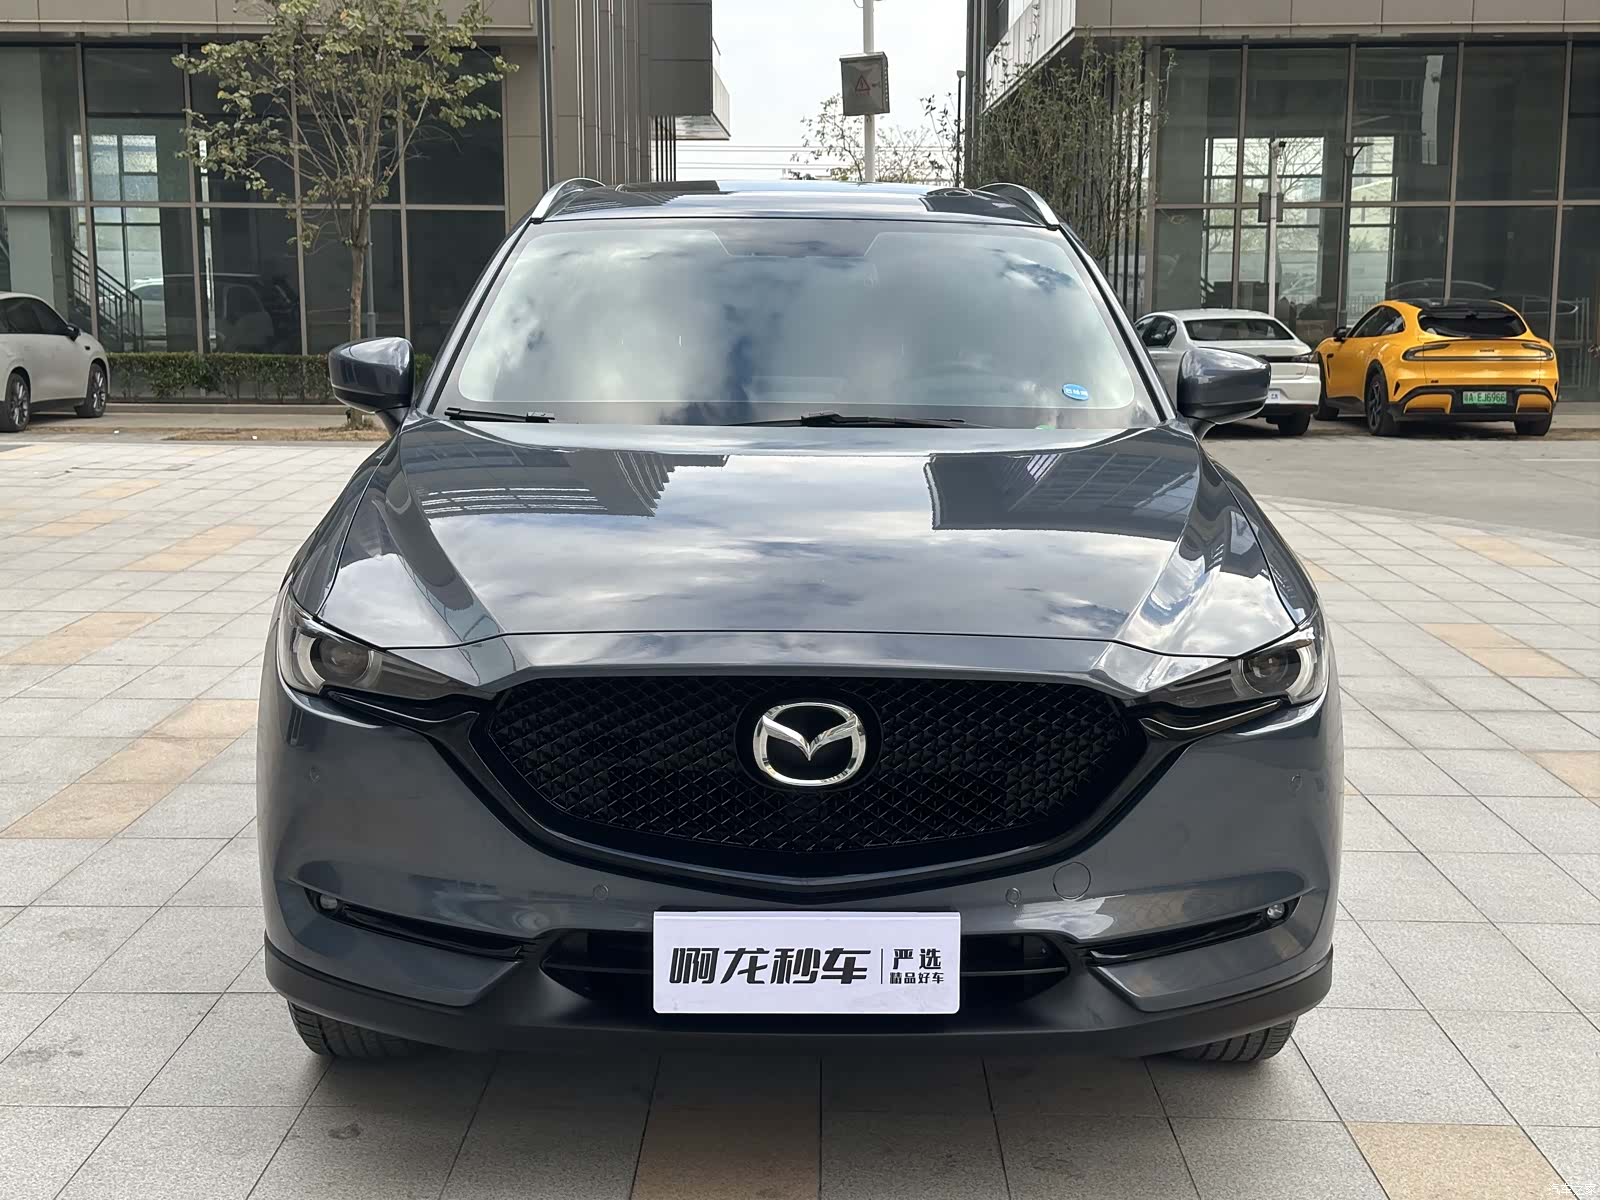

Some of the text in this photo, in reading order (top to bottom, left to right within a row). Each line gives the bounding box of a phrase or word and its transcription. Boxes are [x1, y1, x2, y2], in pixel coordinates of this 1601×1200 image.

[669, 947, 871, 985] 啊龙秒车
[892, 948, 942, 970] 严选
[889, 971, 945, 985] 精品好车
